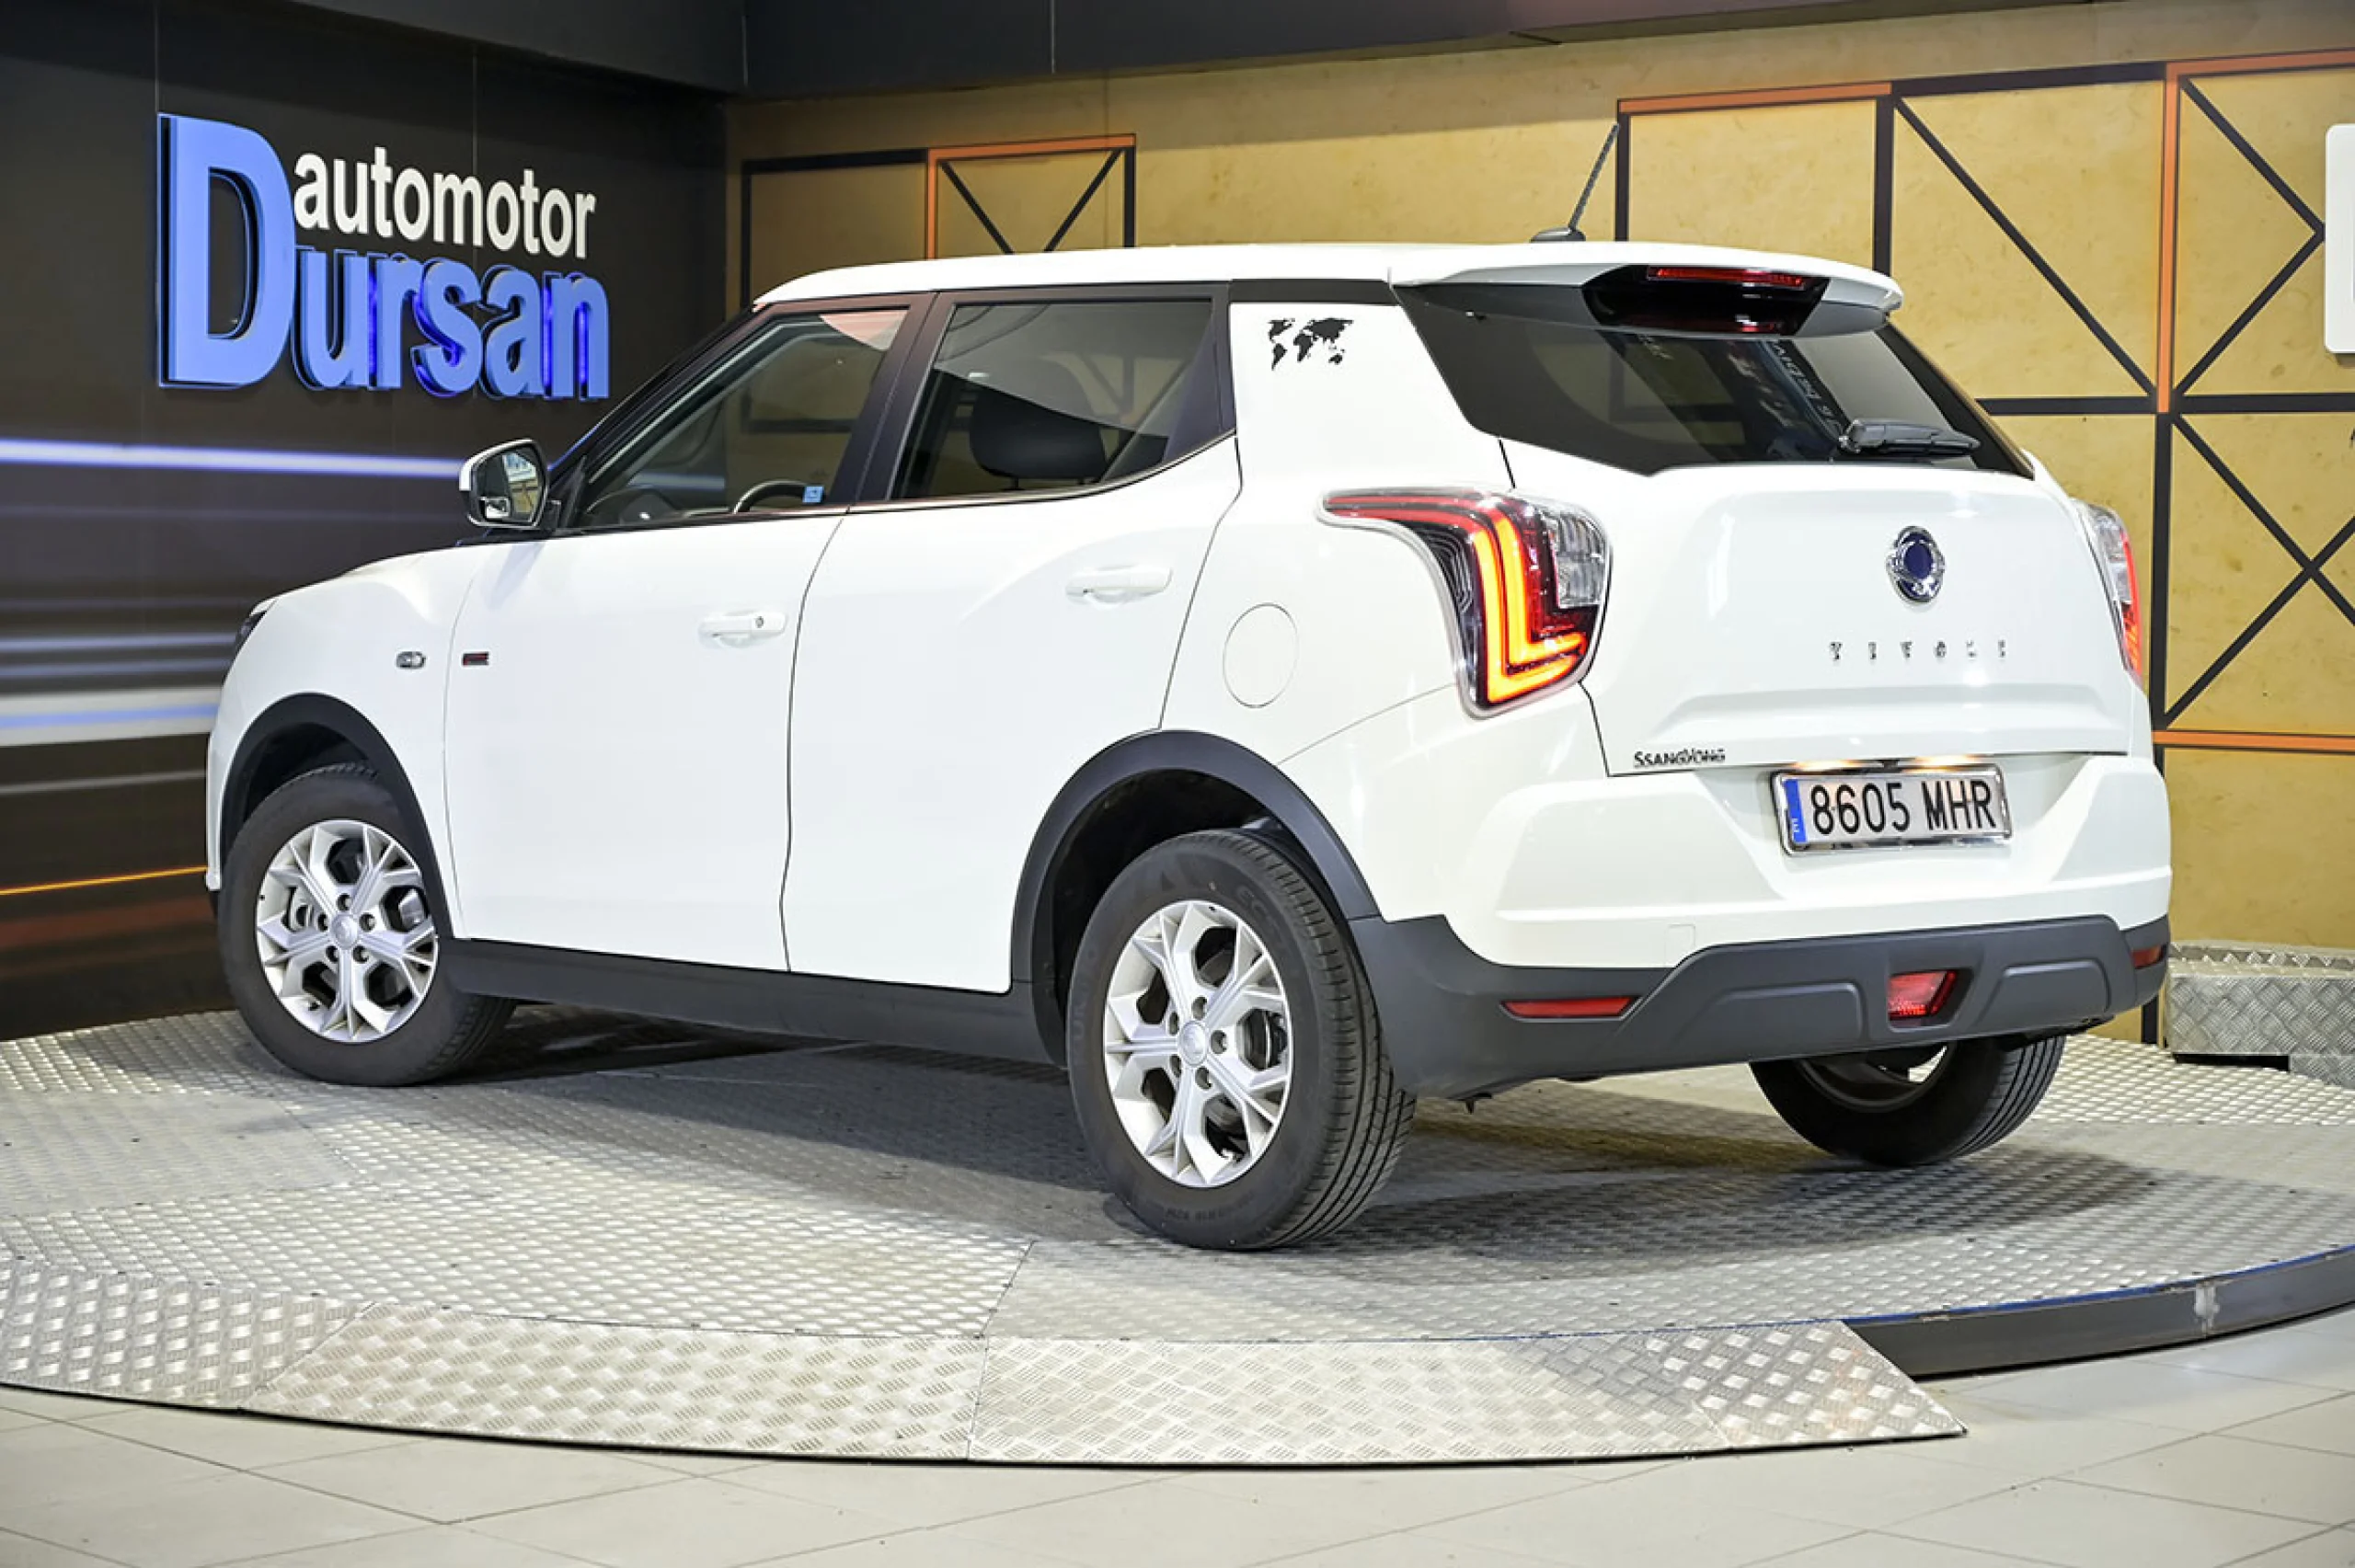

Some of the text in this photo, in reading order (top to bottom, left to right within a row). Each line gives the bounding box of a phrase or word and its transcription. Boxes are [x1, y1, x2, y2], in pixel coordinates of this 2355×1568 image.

[157, 112, 610, 399] Dursan
[293, 146, 597, 258] automotor
[1810, 782, 1911, 836] 8605
[1921, 779, 1997, 831] MHR
